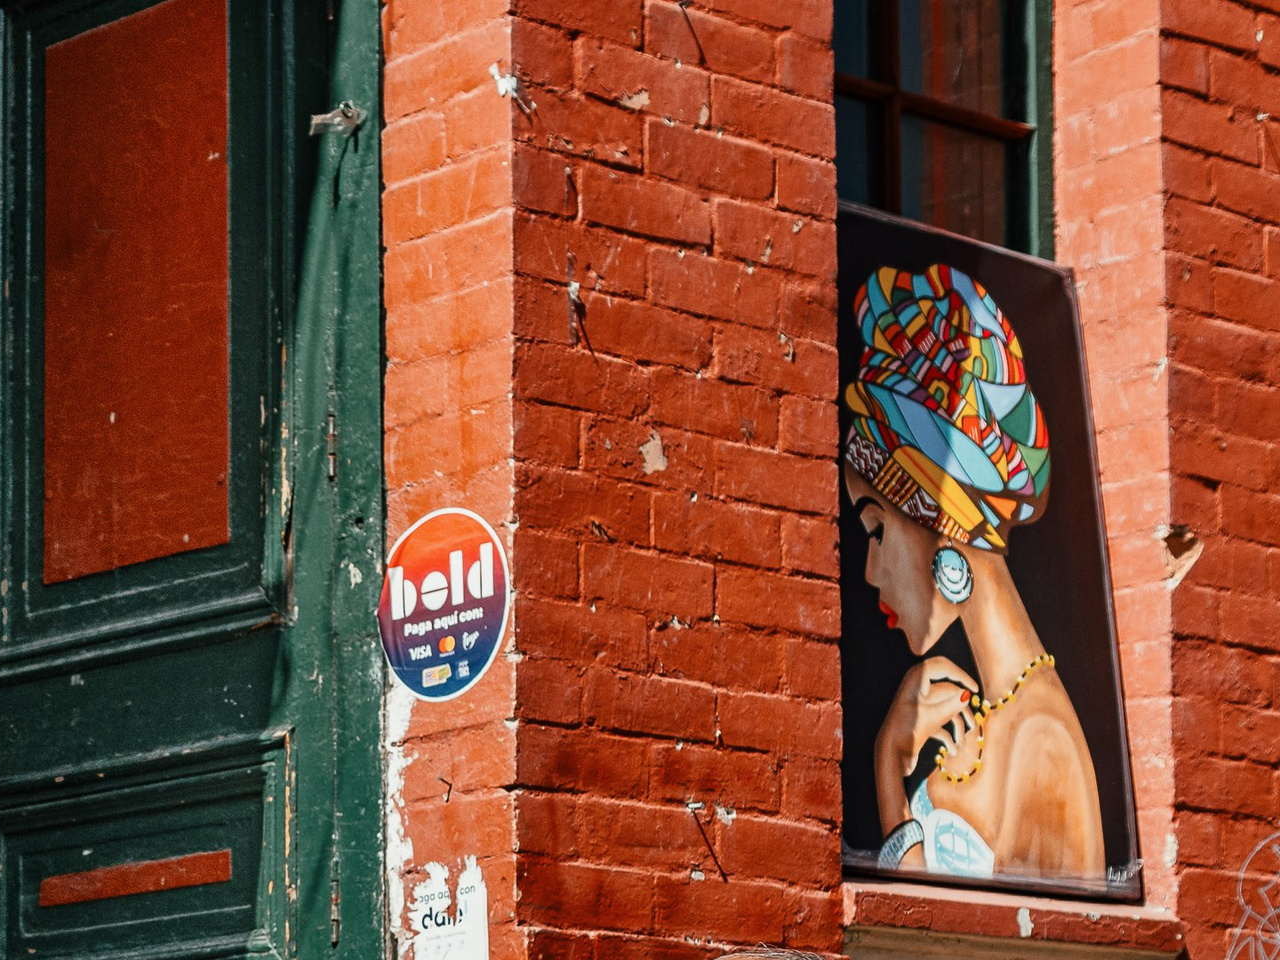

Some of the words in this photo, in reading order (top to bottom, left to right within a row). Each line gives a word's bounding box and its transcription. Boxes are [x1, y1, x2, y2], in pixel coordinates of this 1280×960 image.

[388, 542, 494, 620] bold
[404, 621, 432, 637] Paga
[434, 610, 458, 630] aquí
[409, 644, 432, 661] VISA
[419, 893, 435, 905] aga
[460, 885, 476, 895] con
